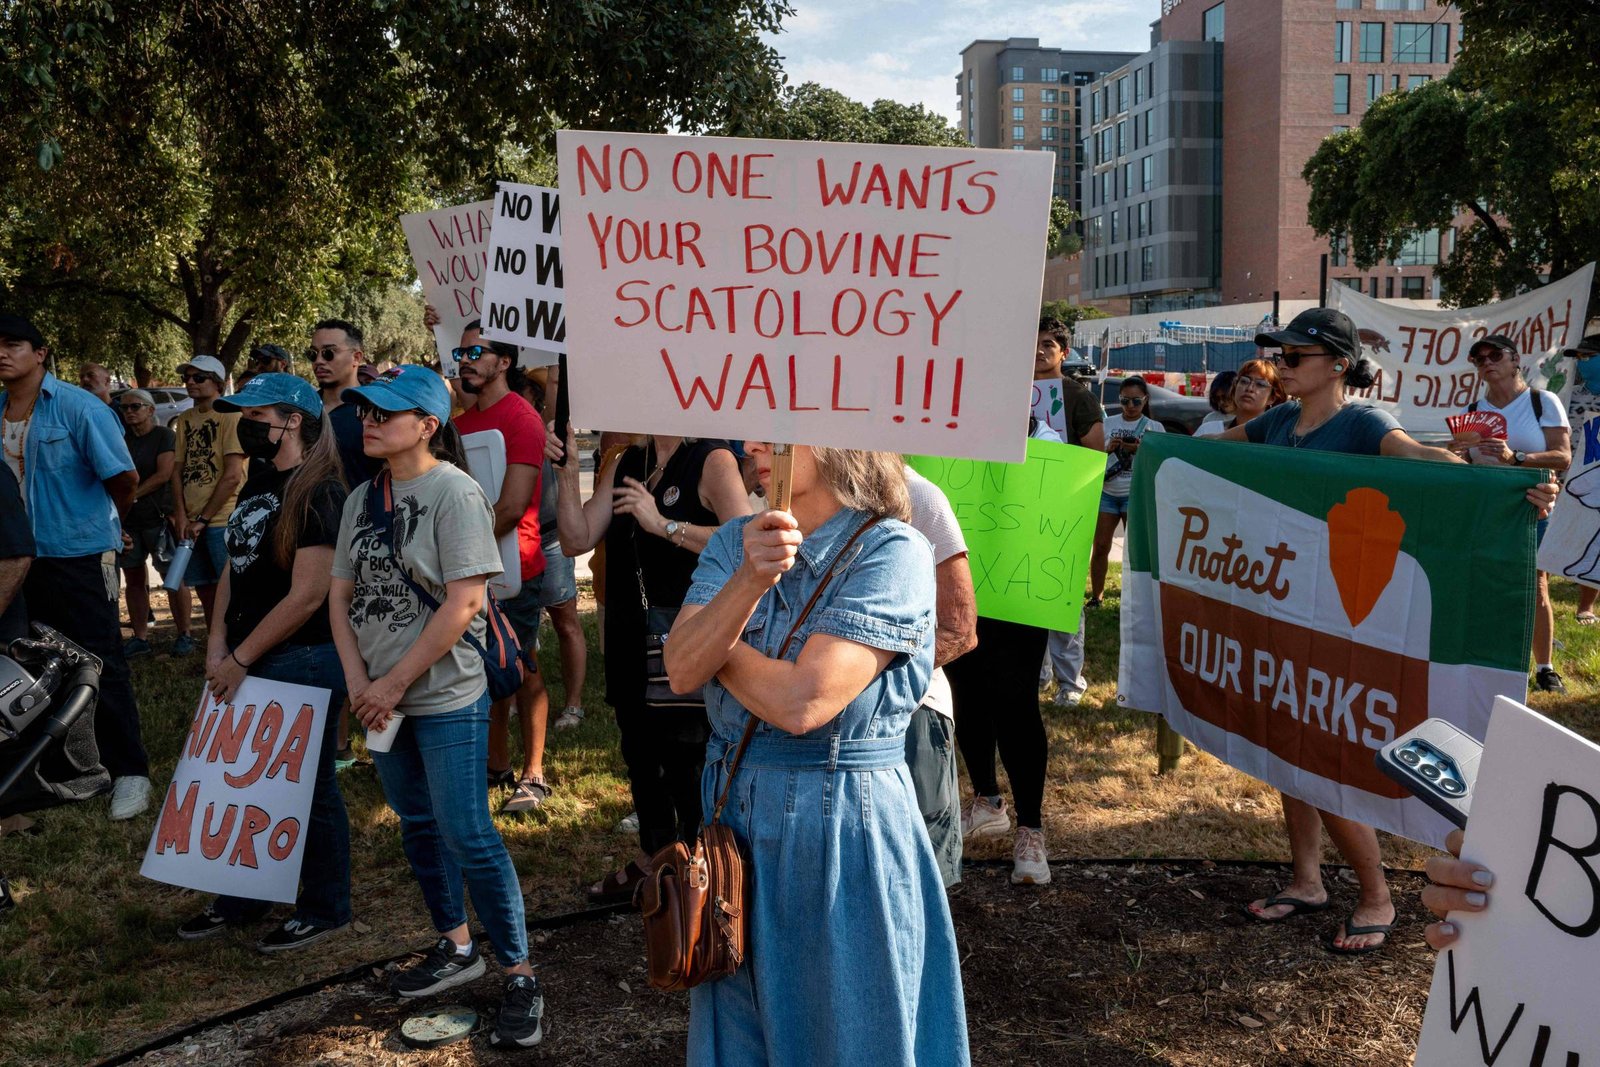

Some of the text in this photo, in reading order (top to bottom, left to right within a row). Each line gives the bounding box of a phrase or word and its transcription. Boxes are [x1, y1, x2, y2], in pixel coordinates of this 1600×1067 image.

[501, 191, 532, 221] NO
[576, 143, 998, 215] NO ONE WANTS
[428, 207, 495, 249] WHA
[588, 211, 952, 278] YOUR BOVINE
[494, 246, 527, 276] NO
[489, 302, 520, 332] NO
[614, 280, 963, 346] SCATOLOGY
[955, 502, 1025, 532] ESS
[369, 556, 391, 572] BIG
[974, 551, 1076, 607] XAS!
[1175, 506, 1297, 600] Protect
[1179, 621, 1398, 751] OUR PARKS
[155, 780, 301, 869] MURO
